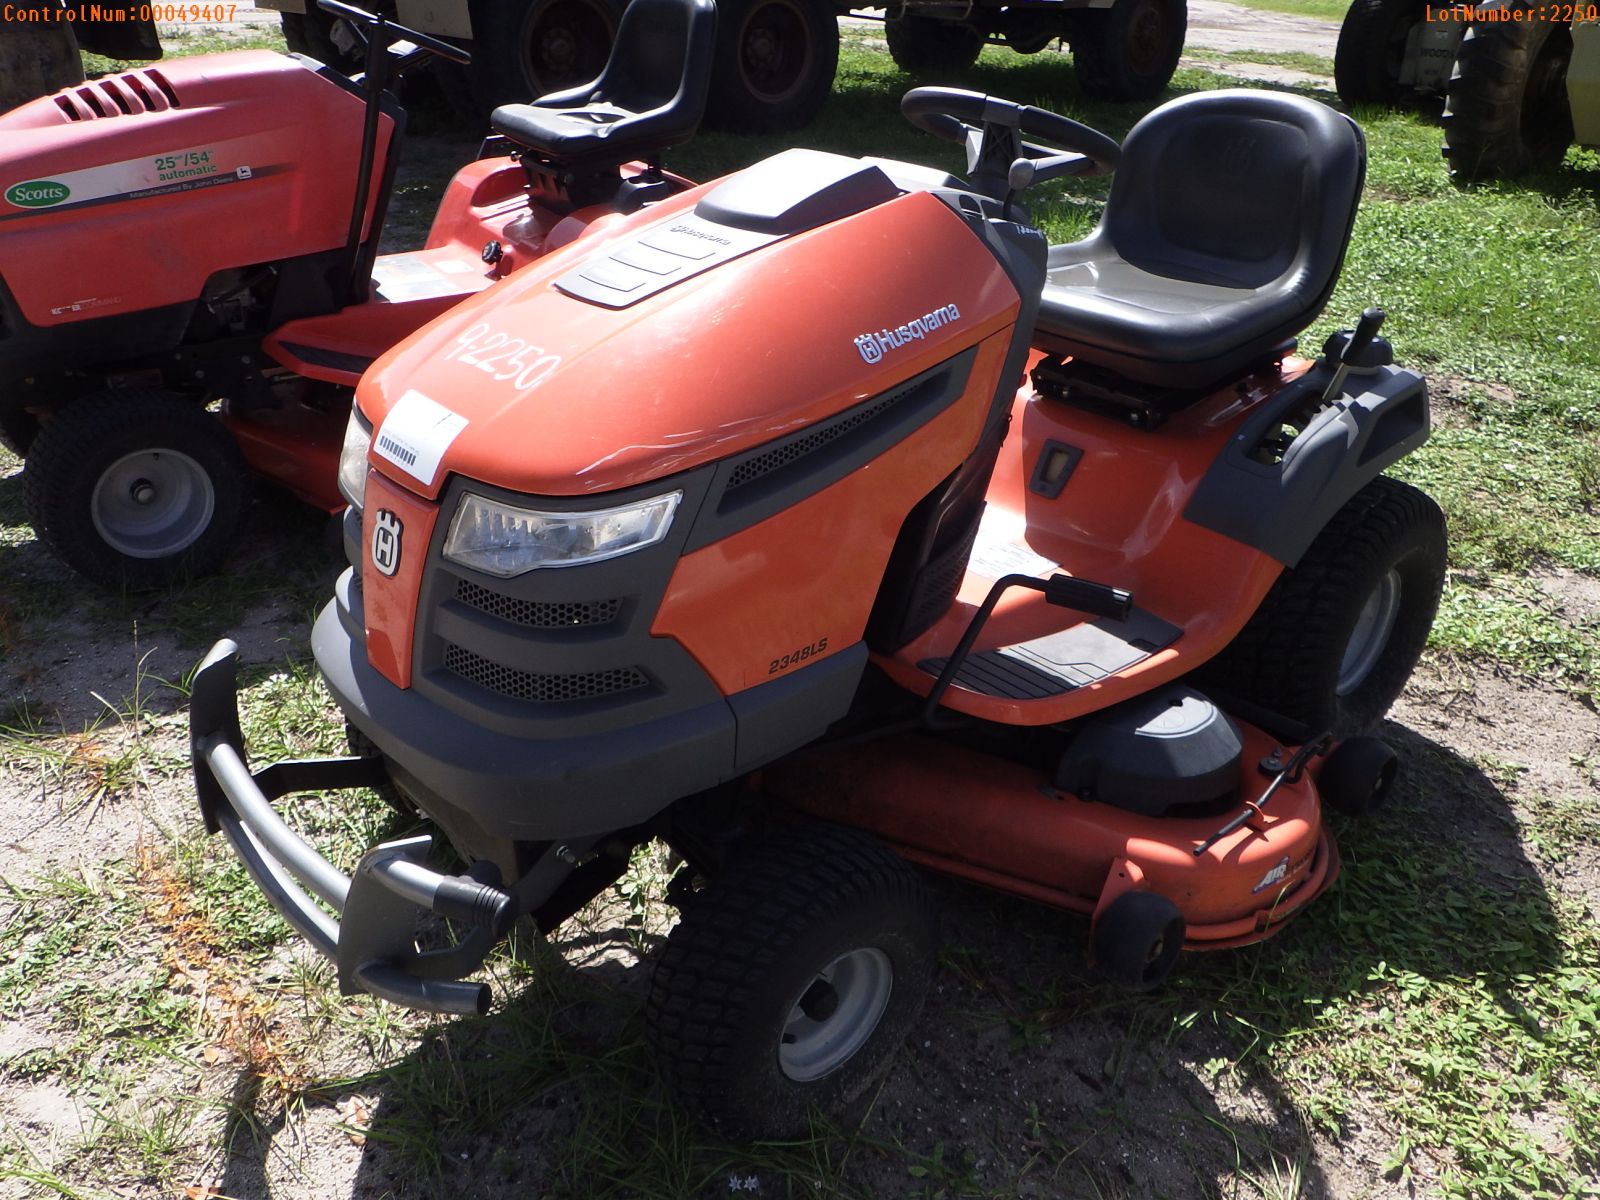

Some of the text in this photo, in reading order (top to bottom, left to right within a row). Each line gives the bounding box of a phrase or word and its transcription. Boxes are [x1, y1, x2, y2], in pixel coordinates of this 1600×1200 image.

[159, 164, 217, 181] automatic
[15, 187, 64, 201] Scotts
[183, 183, 192, 191] By
[874, 303, 961, 353] Husqvarna
[768, 637, 828, 675] 2348LS
